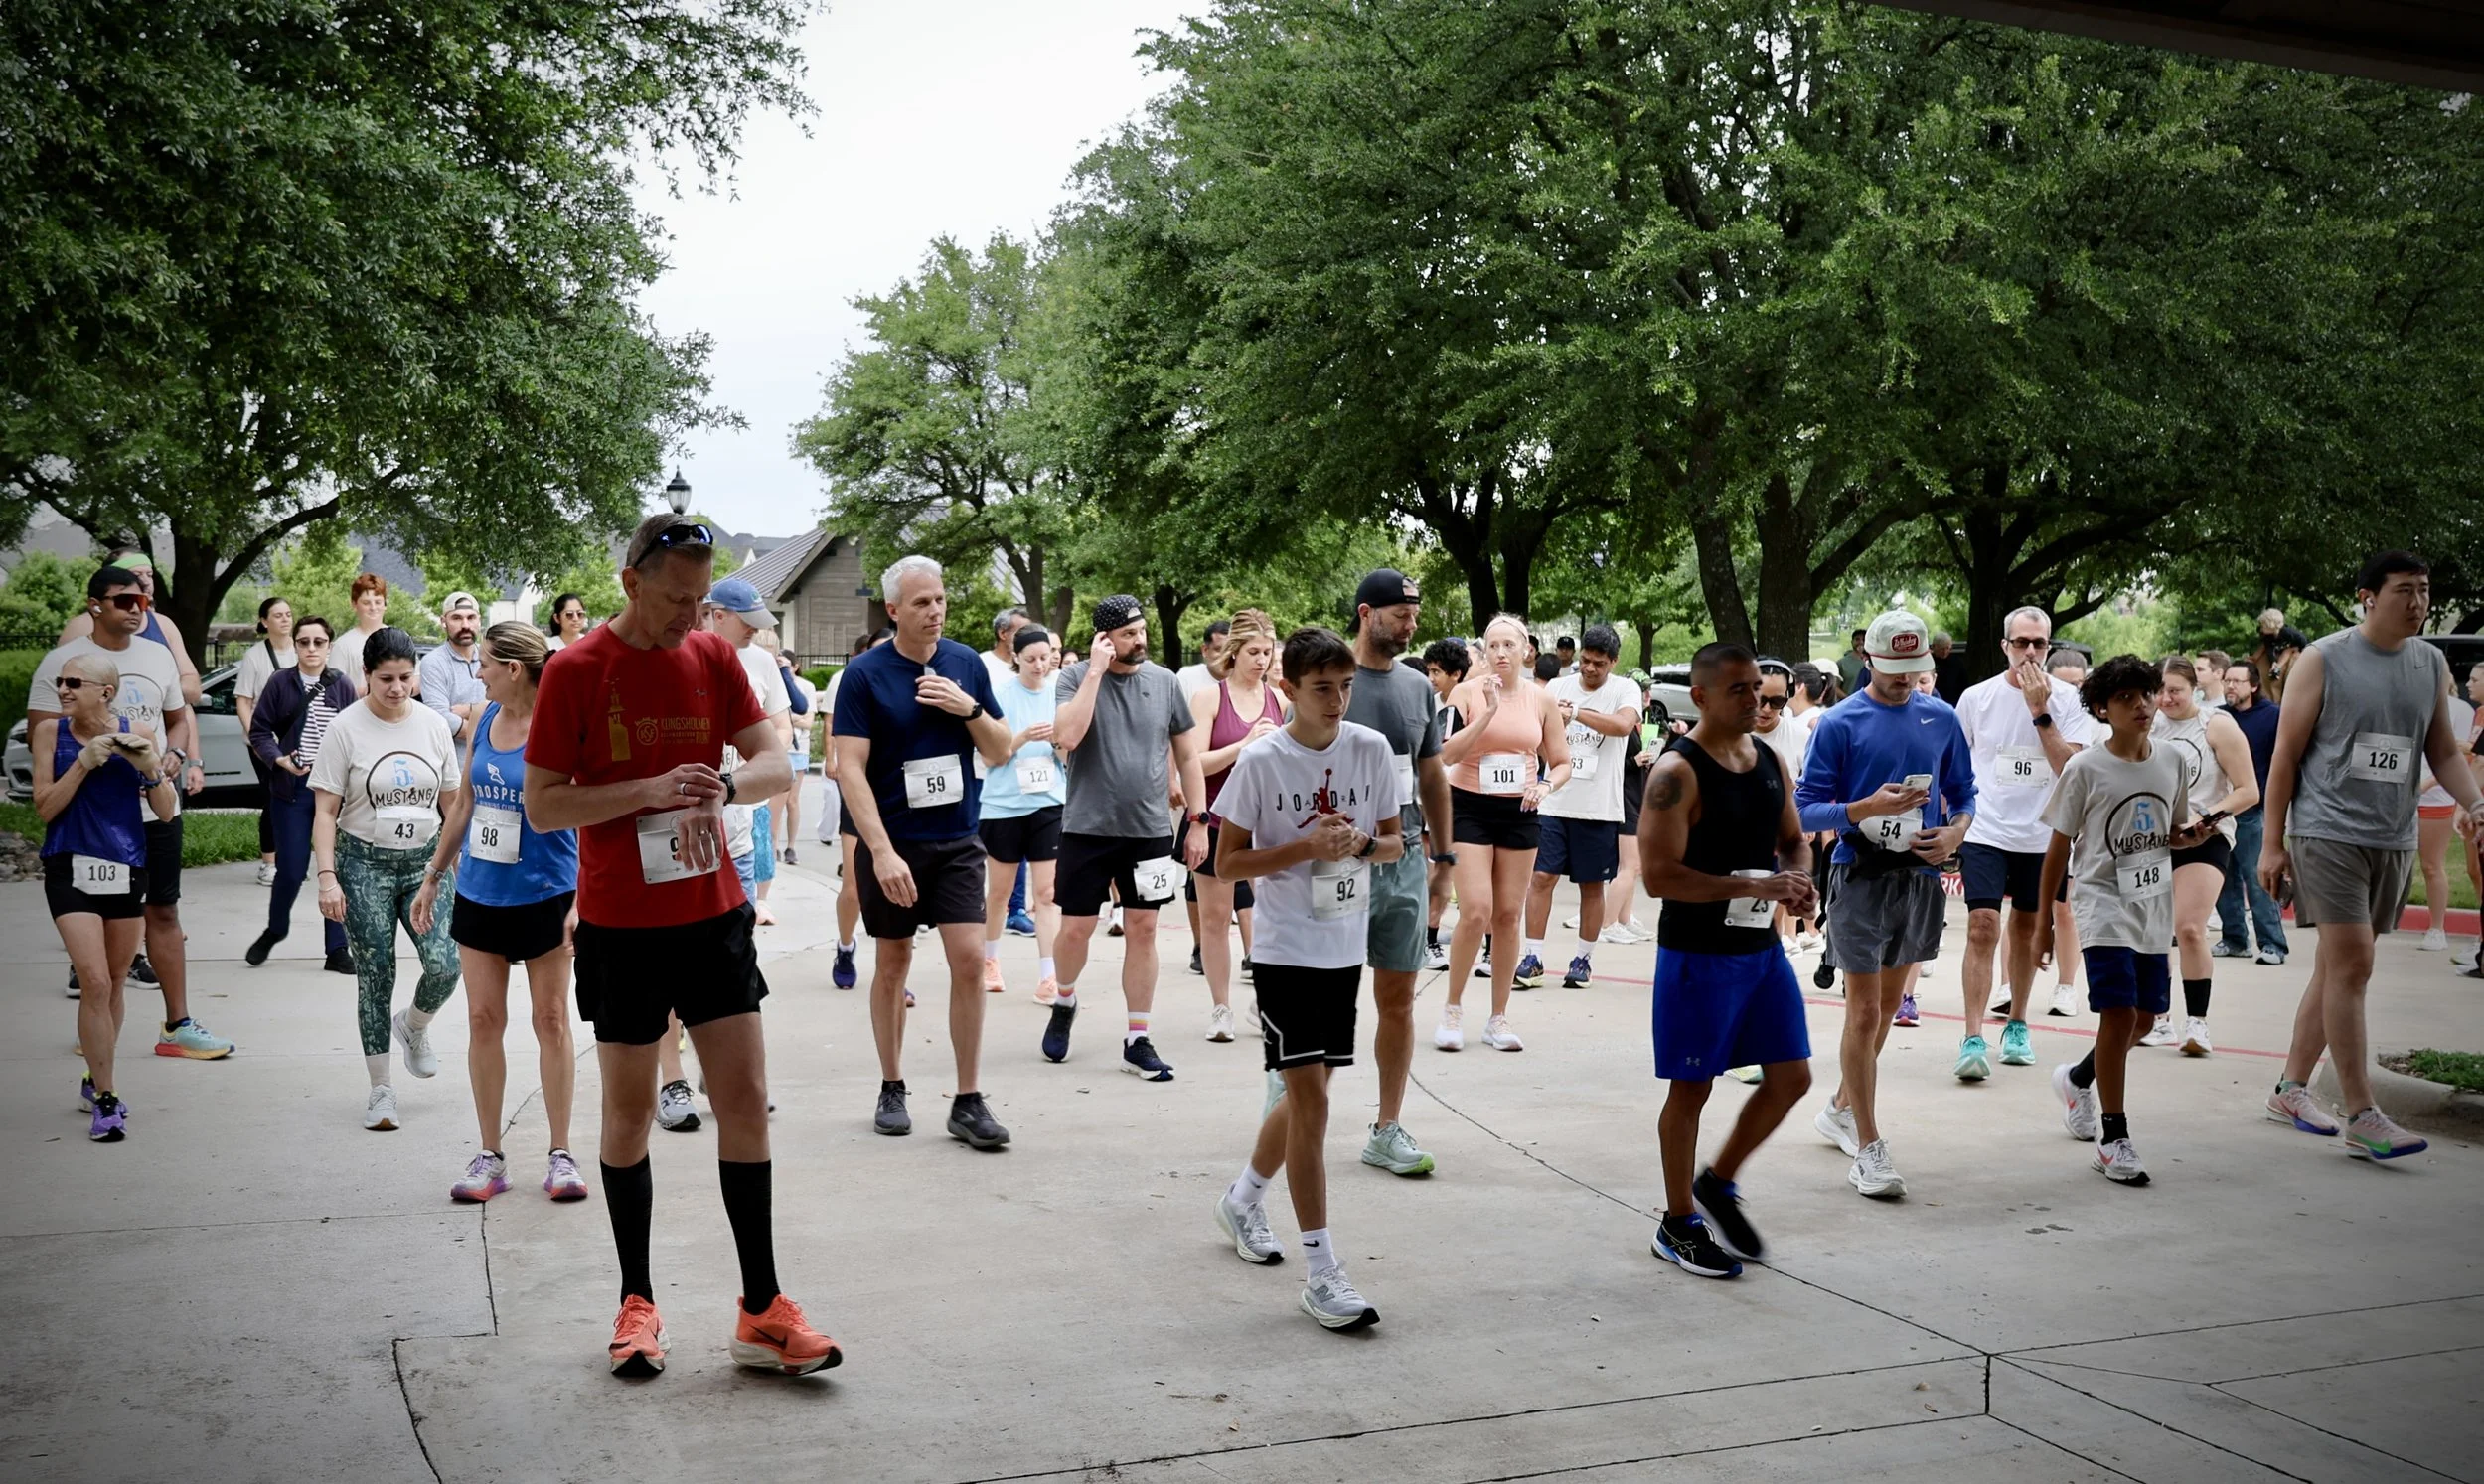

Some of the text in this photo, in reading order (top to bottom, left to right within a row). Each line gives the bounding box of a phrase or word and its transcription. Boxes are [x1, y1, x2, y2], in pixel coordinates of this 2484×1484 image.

[2013, 761, 2032, 776] 96
[2368, 751, 2398, 770] 126
[926, 775, 946, 794] 59
[1029, 770, 1049, 783] 121
[1493, 769, 1515, 783] 101
[375, 787, 433, 807] MUSTANG
[394, 822, 415, 839] 43
[481, 826, 499, 847] 98
[1879, 819, 1902, 839] 54
[2114, 831, 2170, 854] MUSTANG
[87, 864, 116, 882] 103
[1152, 873, 1167, 890] 25
[2134, 867, 2160, 889] 148
[1336, 878, 1355, 902] 92
